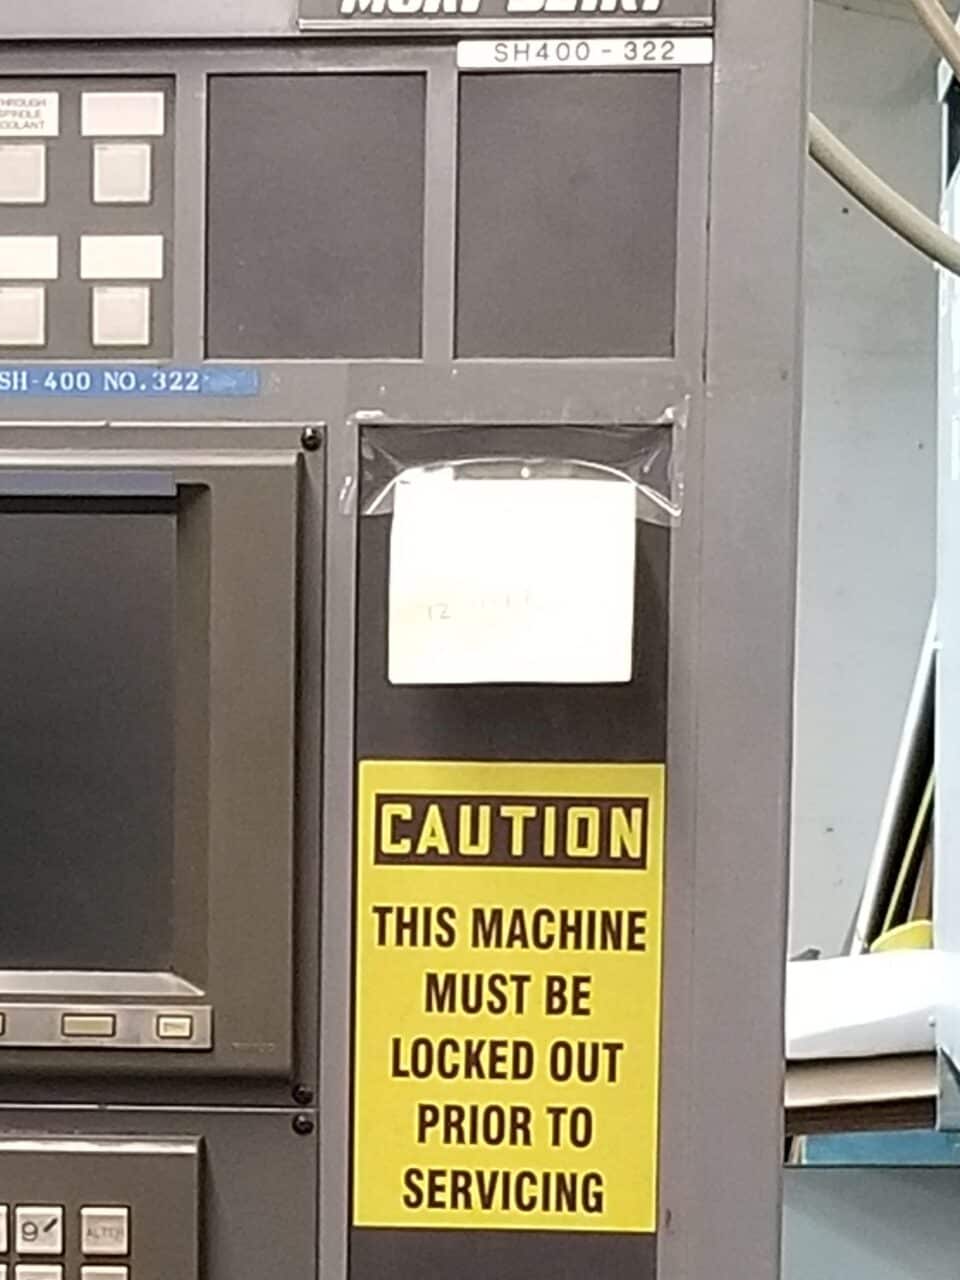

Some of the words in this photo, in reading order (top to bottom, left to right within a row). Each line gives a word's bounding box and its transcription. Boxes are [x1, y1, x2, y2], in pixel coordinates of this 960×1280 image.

[103, 371, 200, 391] NO.322
[380, 803, 642, 858] CAUTION
[372, 905, 456, 948] THIS
[472, 908, 647, 952] MACHINE
[425, 972, 531, 1015] MUST
[545, 975, 592, 1016] BE
[391, 1037, 534, 1080] LOCKED
[549, 1040, 624, 1083] OUT
[417, 1104, 532, 1146] PRIOR
[547, 1107, 593, 1147] TO
[403, 1168, 604, 1213] SERVICING
[21, 1221, 39, 1242] 9
